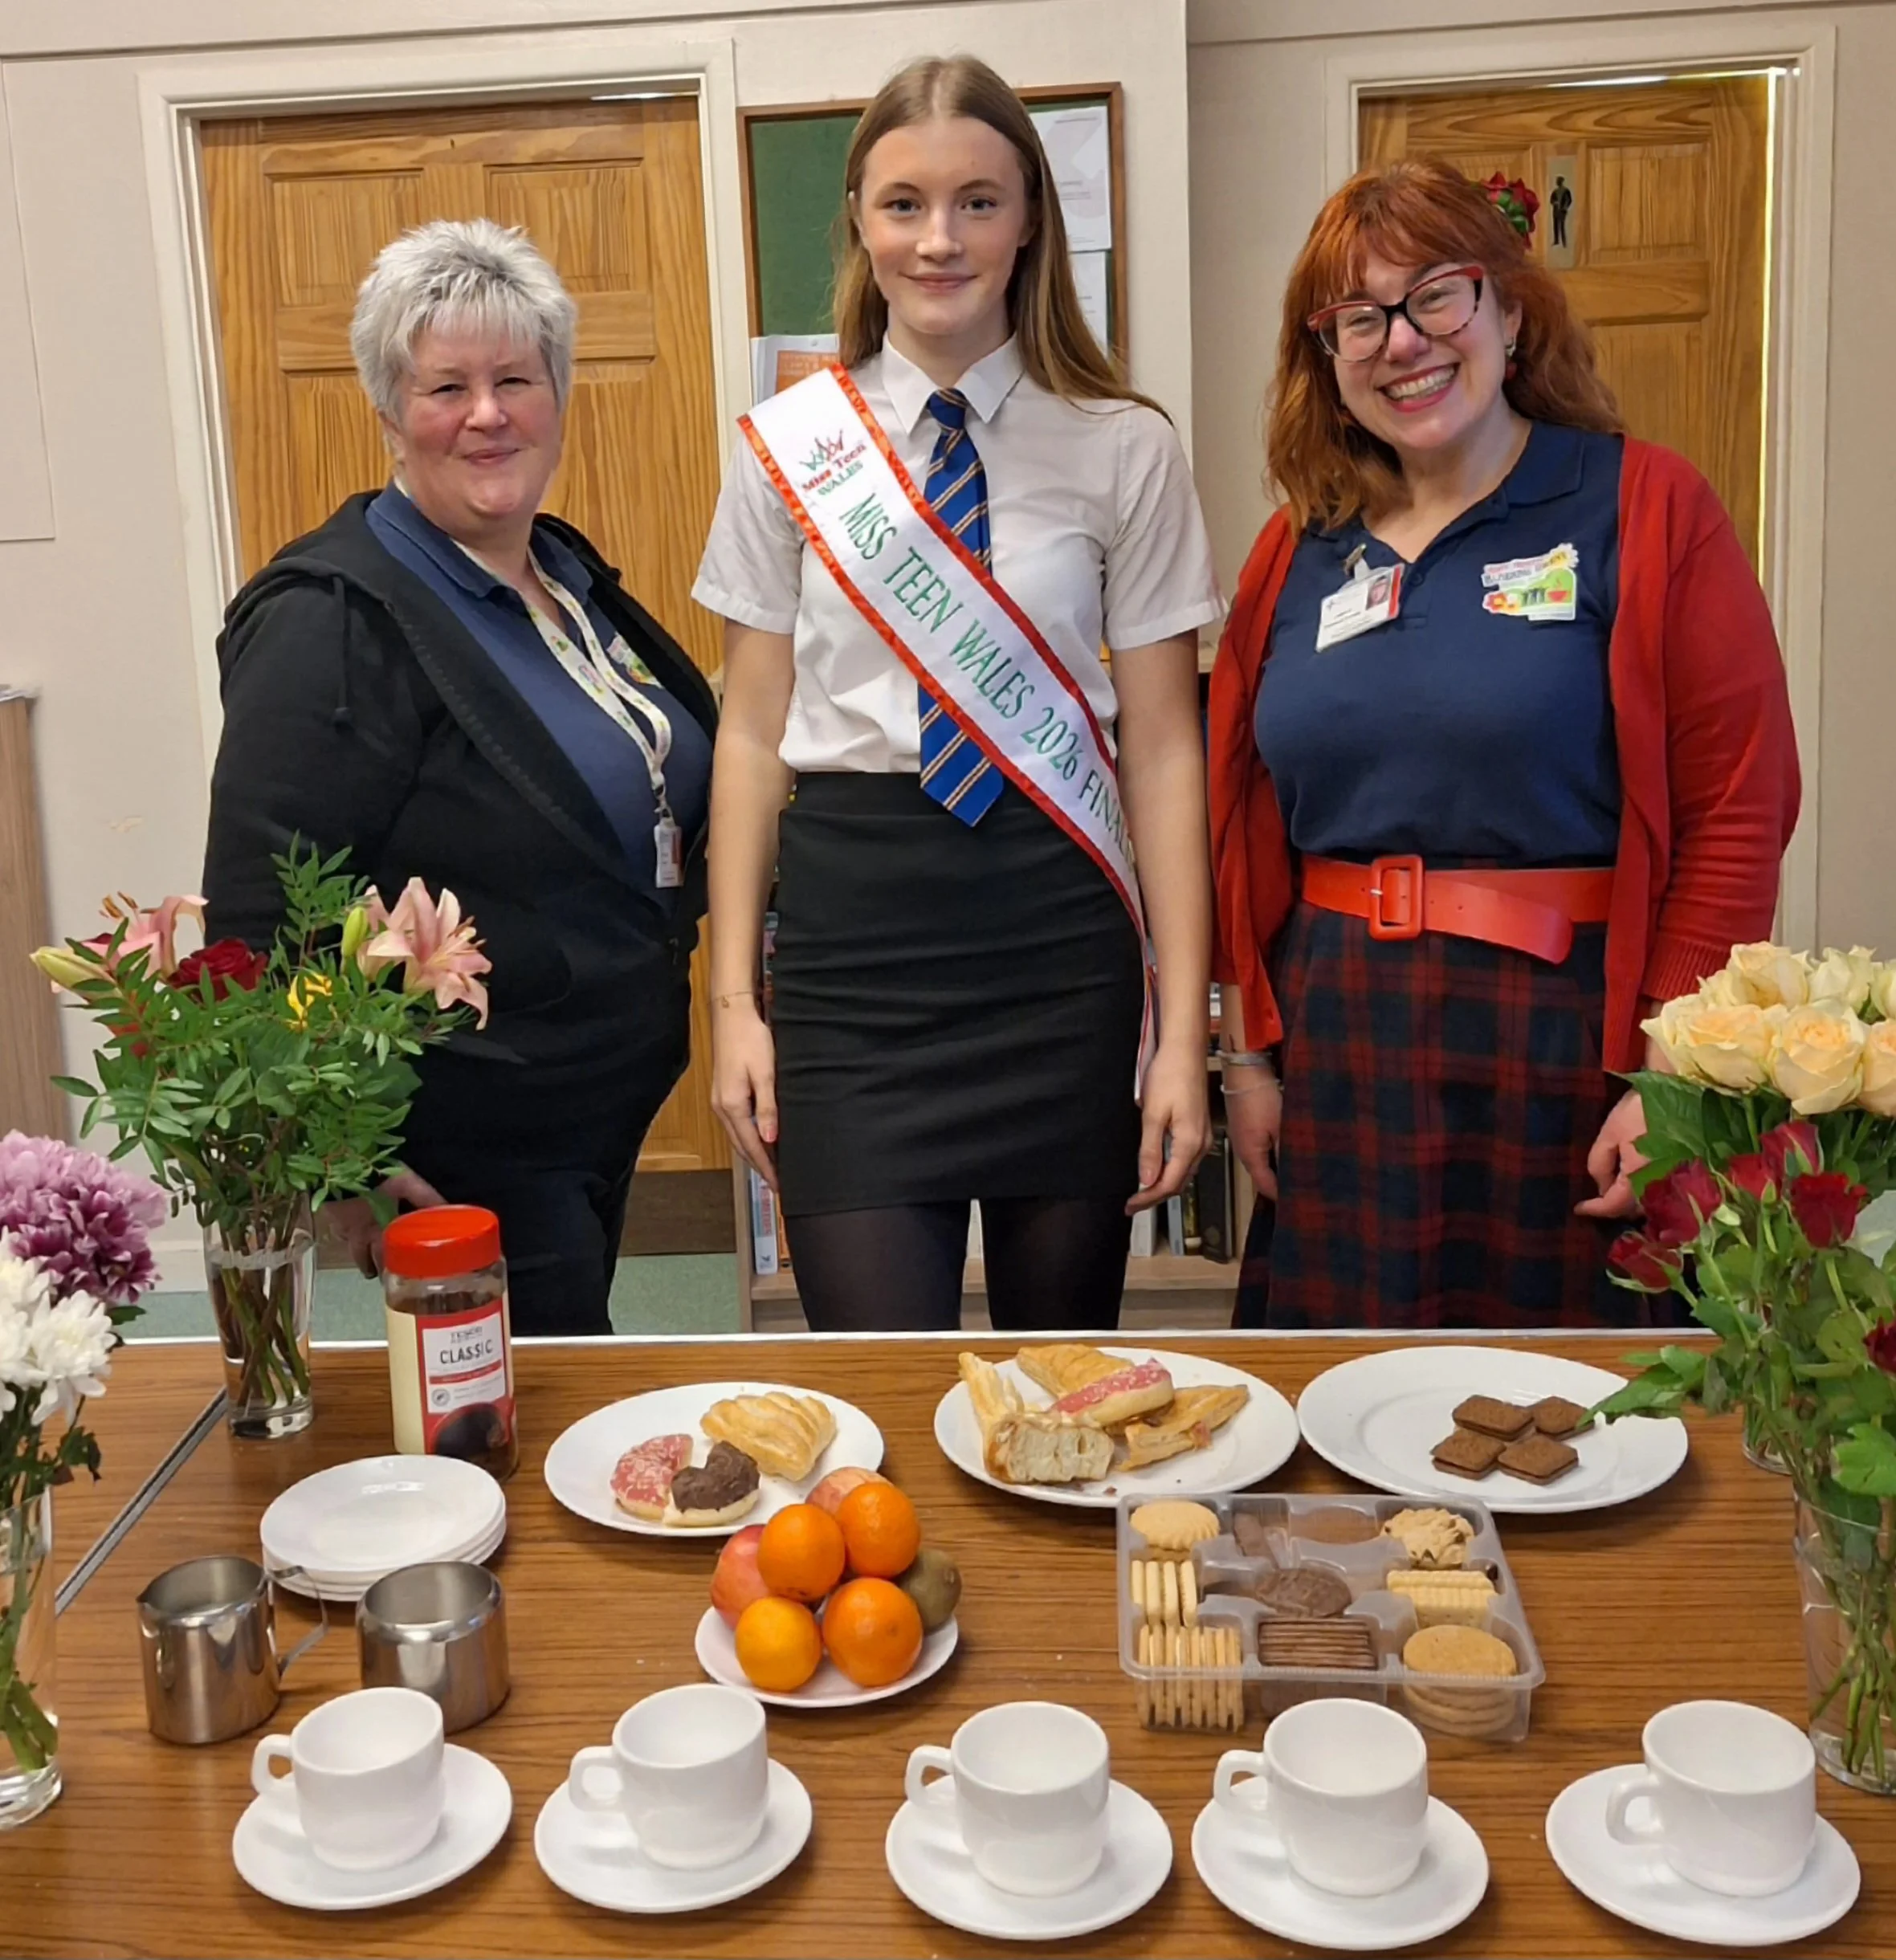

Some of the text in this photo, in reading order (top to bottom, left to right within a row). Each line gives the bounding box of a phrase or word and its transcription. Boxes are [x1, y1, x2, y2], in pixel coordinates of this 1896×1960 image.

[818, 460, 863, 495] WALES
[838, 491, 898, 560] MISS
[883, 546, 964, 634] TEEN
[948, 619, 1036, 719] WALES
[1019, 707, 1084, 782] 2026
[439, 1339, 493, 1364] CLASSIC
